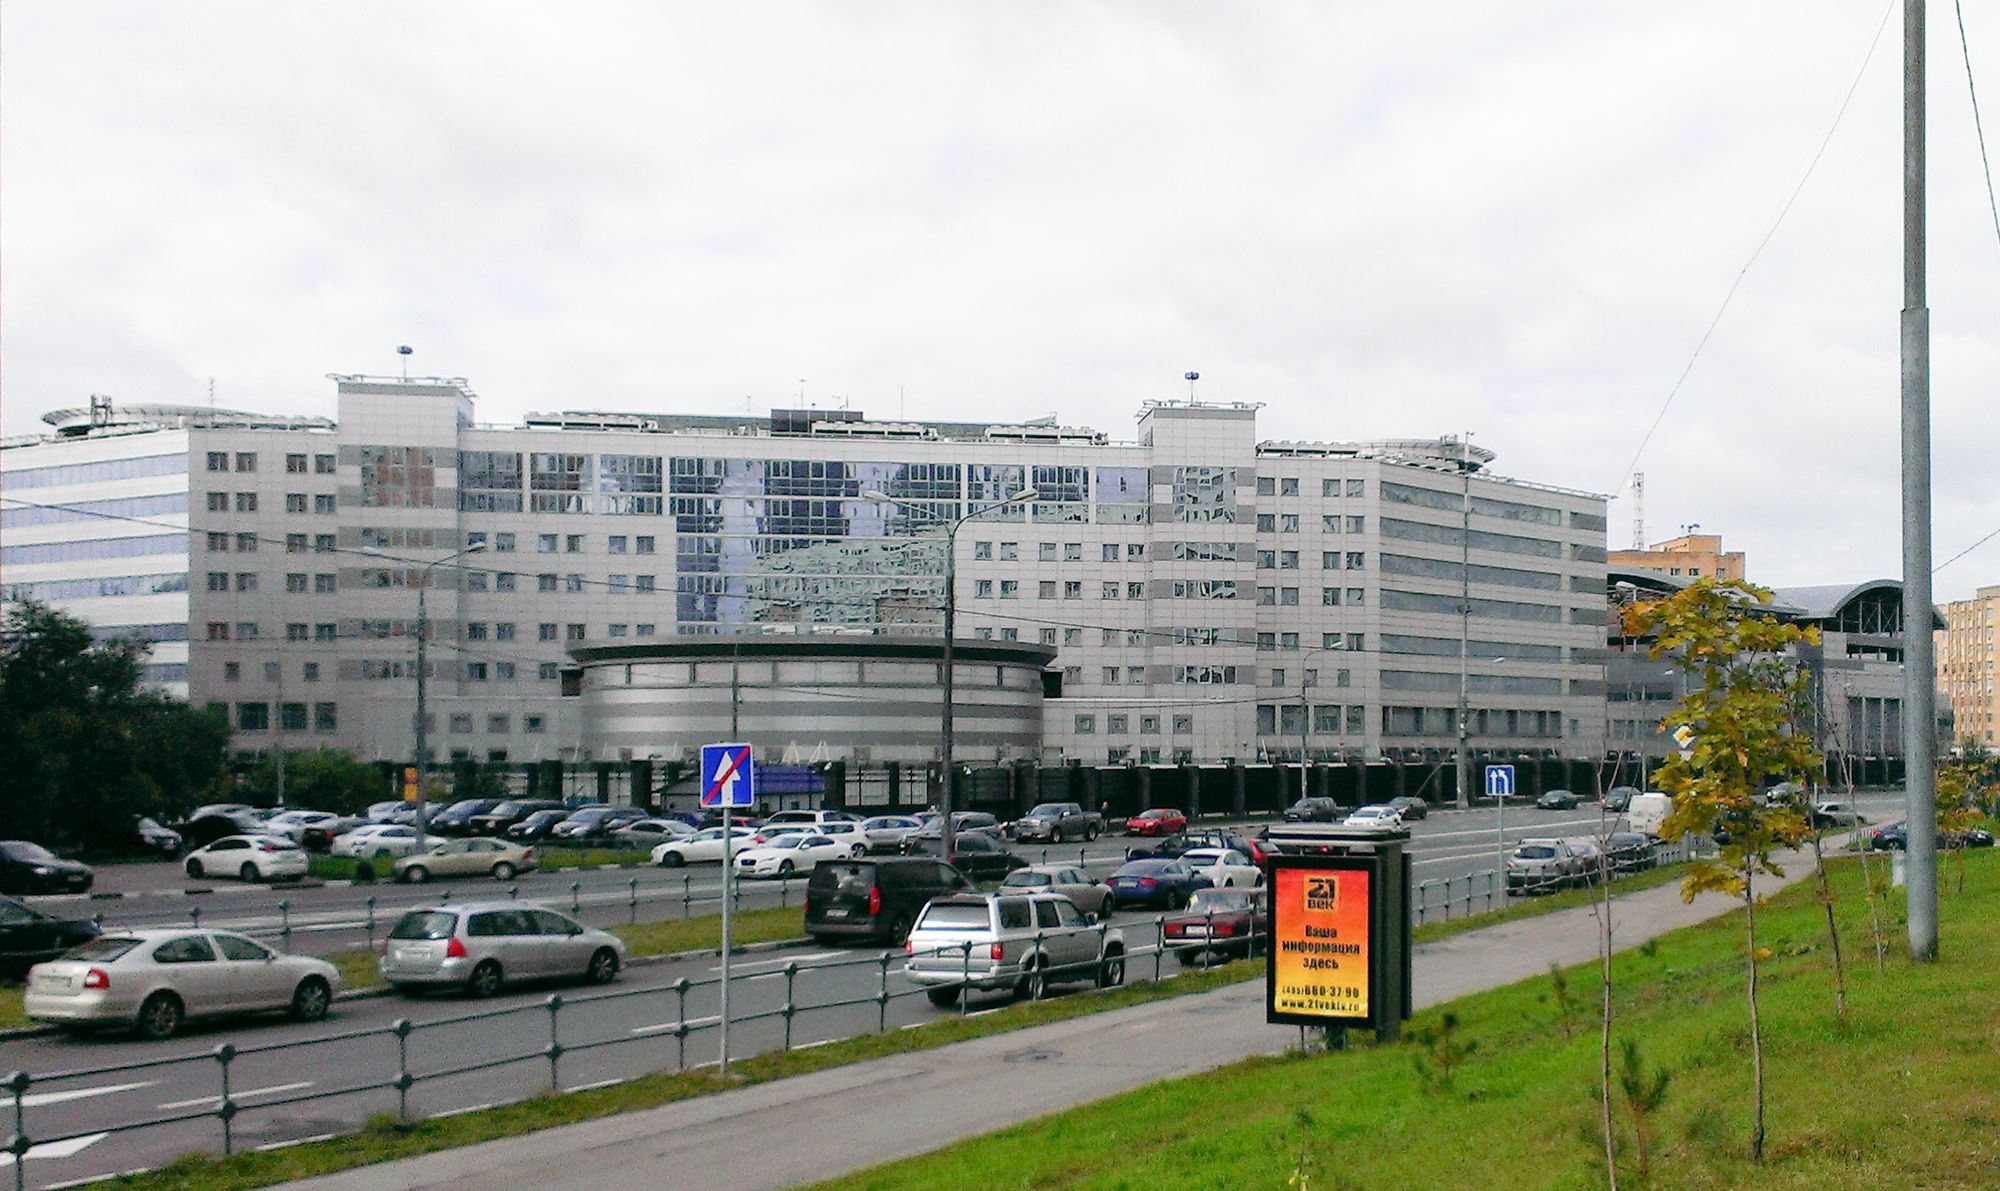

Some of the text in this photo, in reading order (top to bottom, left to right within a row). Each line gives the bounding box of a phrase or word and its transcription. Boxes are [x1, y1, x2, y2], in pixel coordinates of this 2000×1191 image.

[1308, 878, 1335, 899] 21
[1305, 925, 1337, 938] Ваша
[1282, 940, 1360, 954] информация
[1303, 957, 1339, 970] здесь
